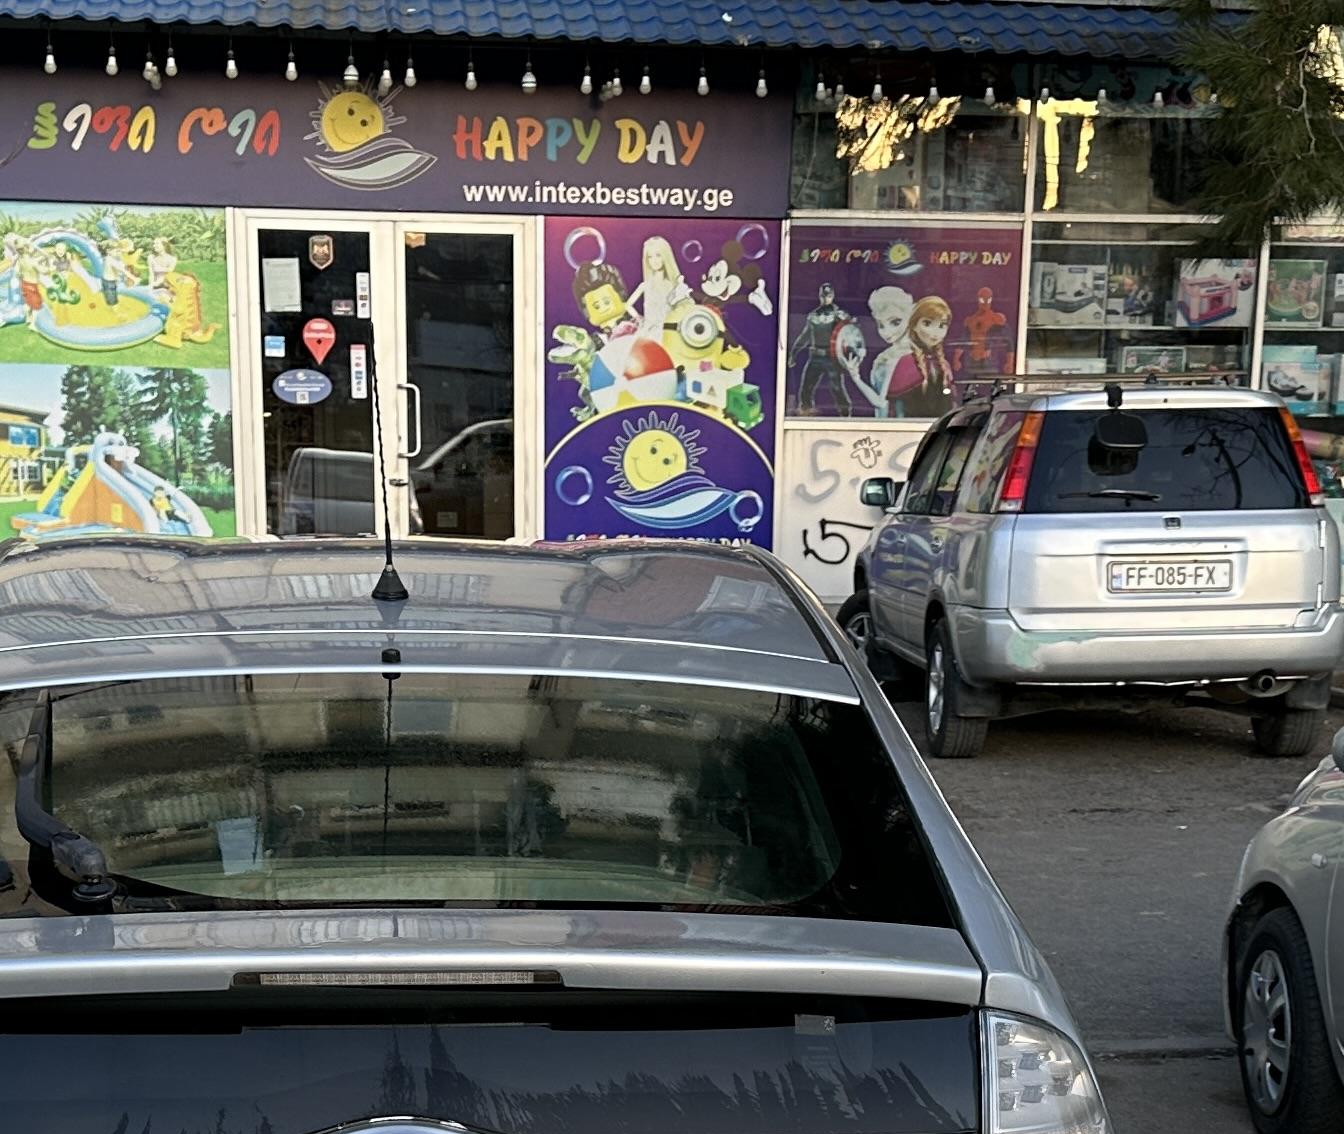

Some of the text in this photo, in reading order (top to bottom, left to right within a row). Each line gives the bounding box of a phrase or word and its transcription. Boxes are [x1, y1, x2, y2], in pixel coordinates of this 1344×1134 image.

[453, 115, 705, 167] HAPPY DAY
[463, 180, 734, 211] www.intexbestway.ge
[930, 251, 1012, 265] HAPPY DAY
[1125, 565, 1216, 587] FF-085-FX
